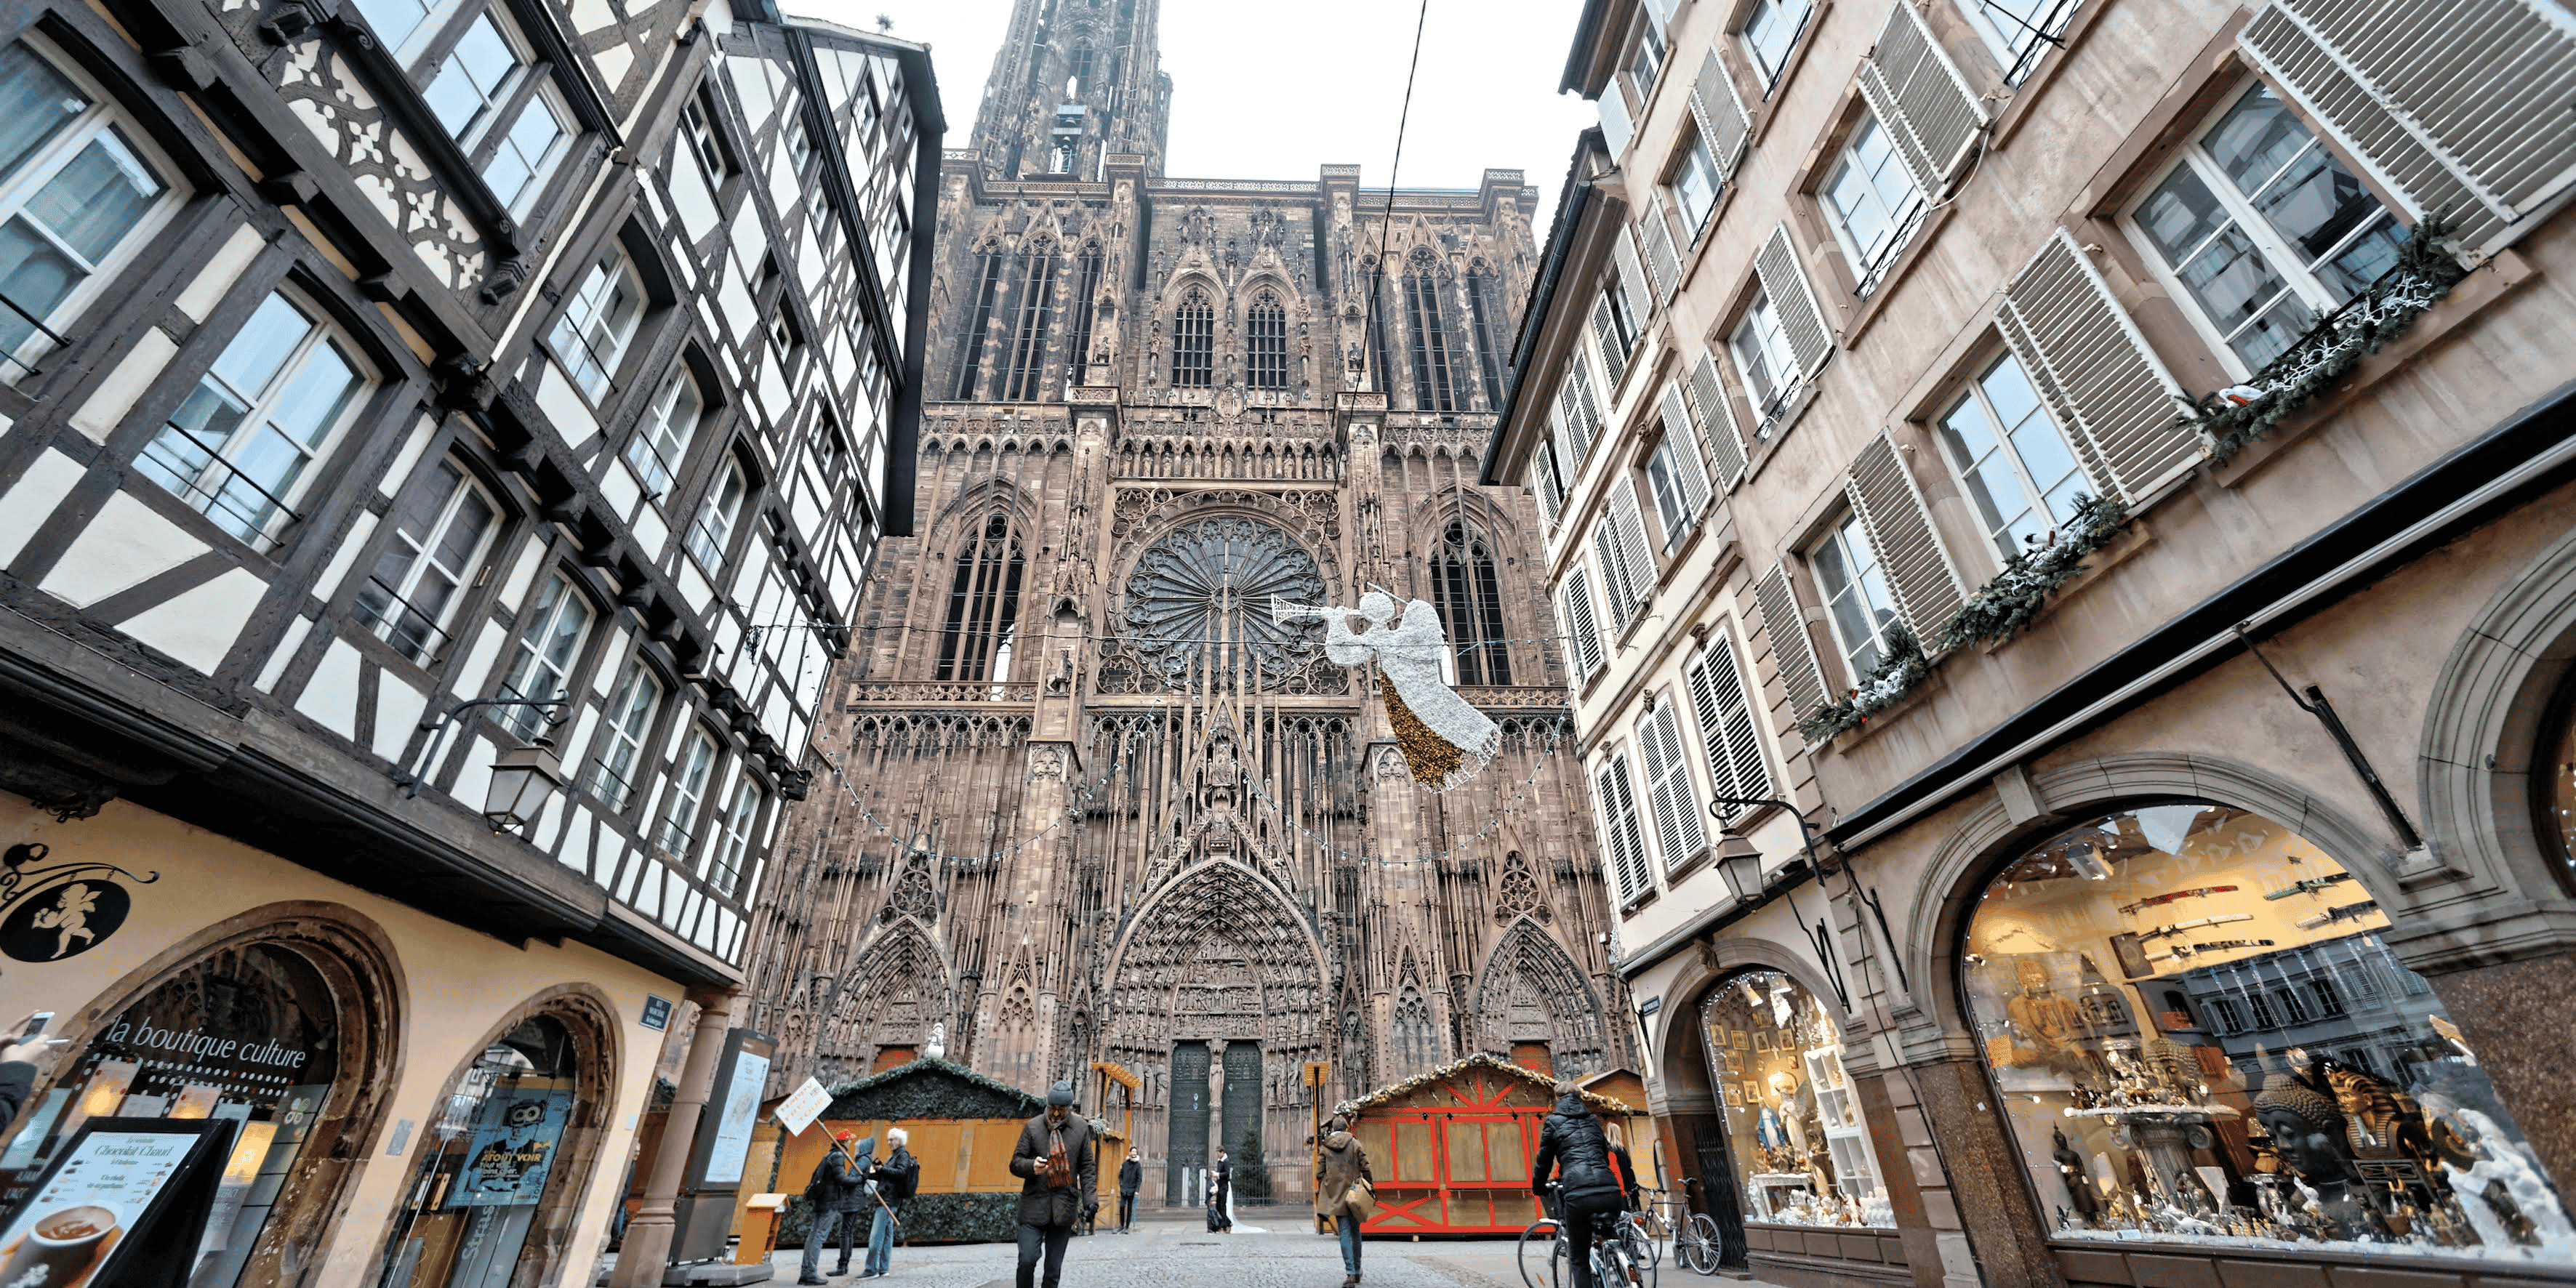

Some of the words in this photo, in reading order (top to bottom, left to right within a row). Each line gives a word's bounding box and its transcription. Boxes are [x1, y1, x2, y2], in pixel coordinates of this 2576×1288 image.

[105, 1014, 131, 1042] la
[132, 1016, 236, 1062] boutique
[239, 1038, 305, 1068] culture
[517, 1153, 542, 1162] VOIR
